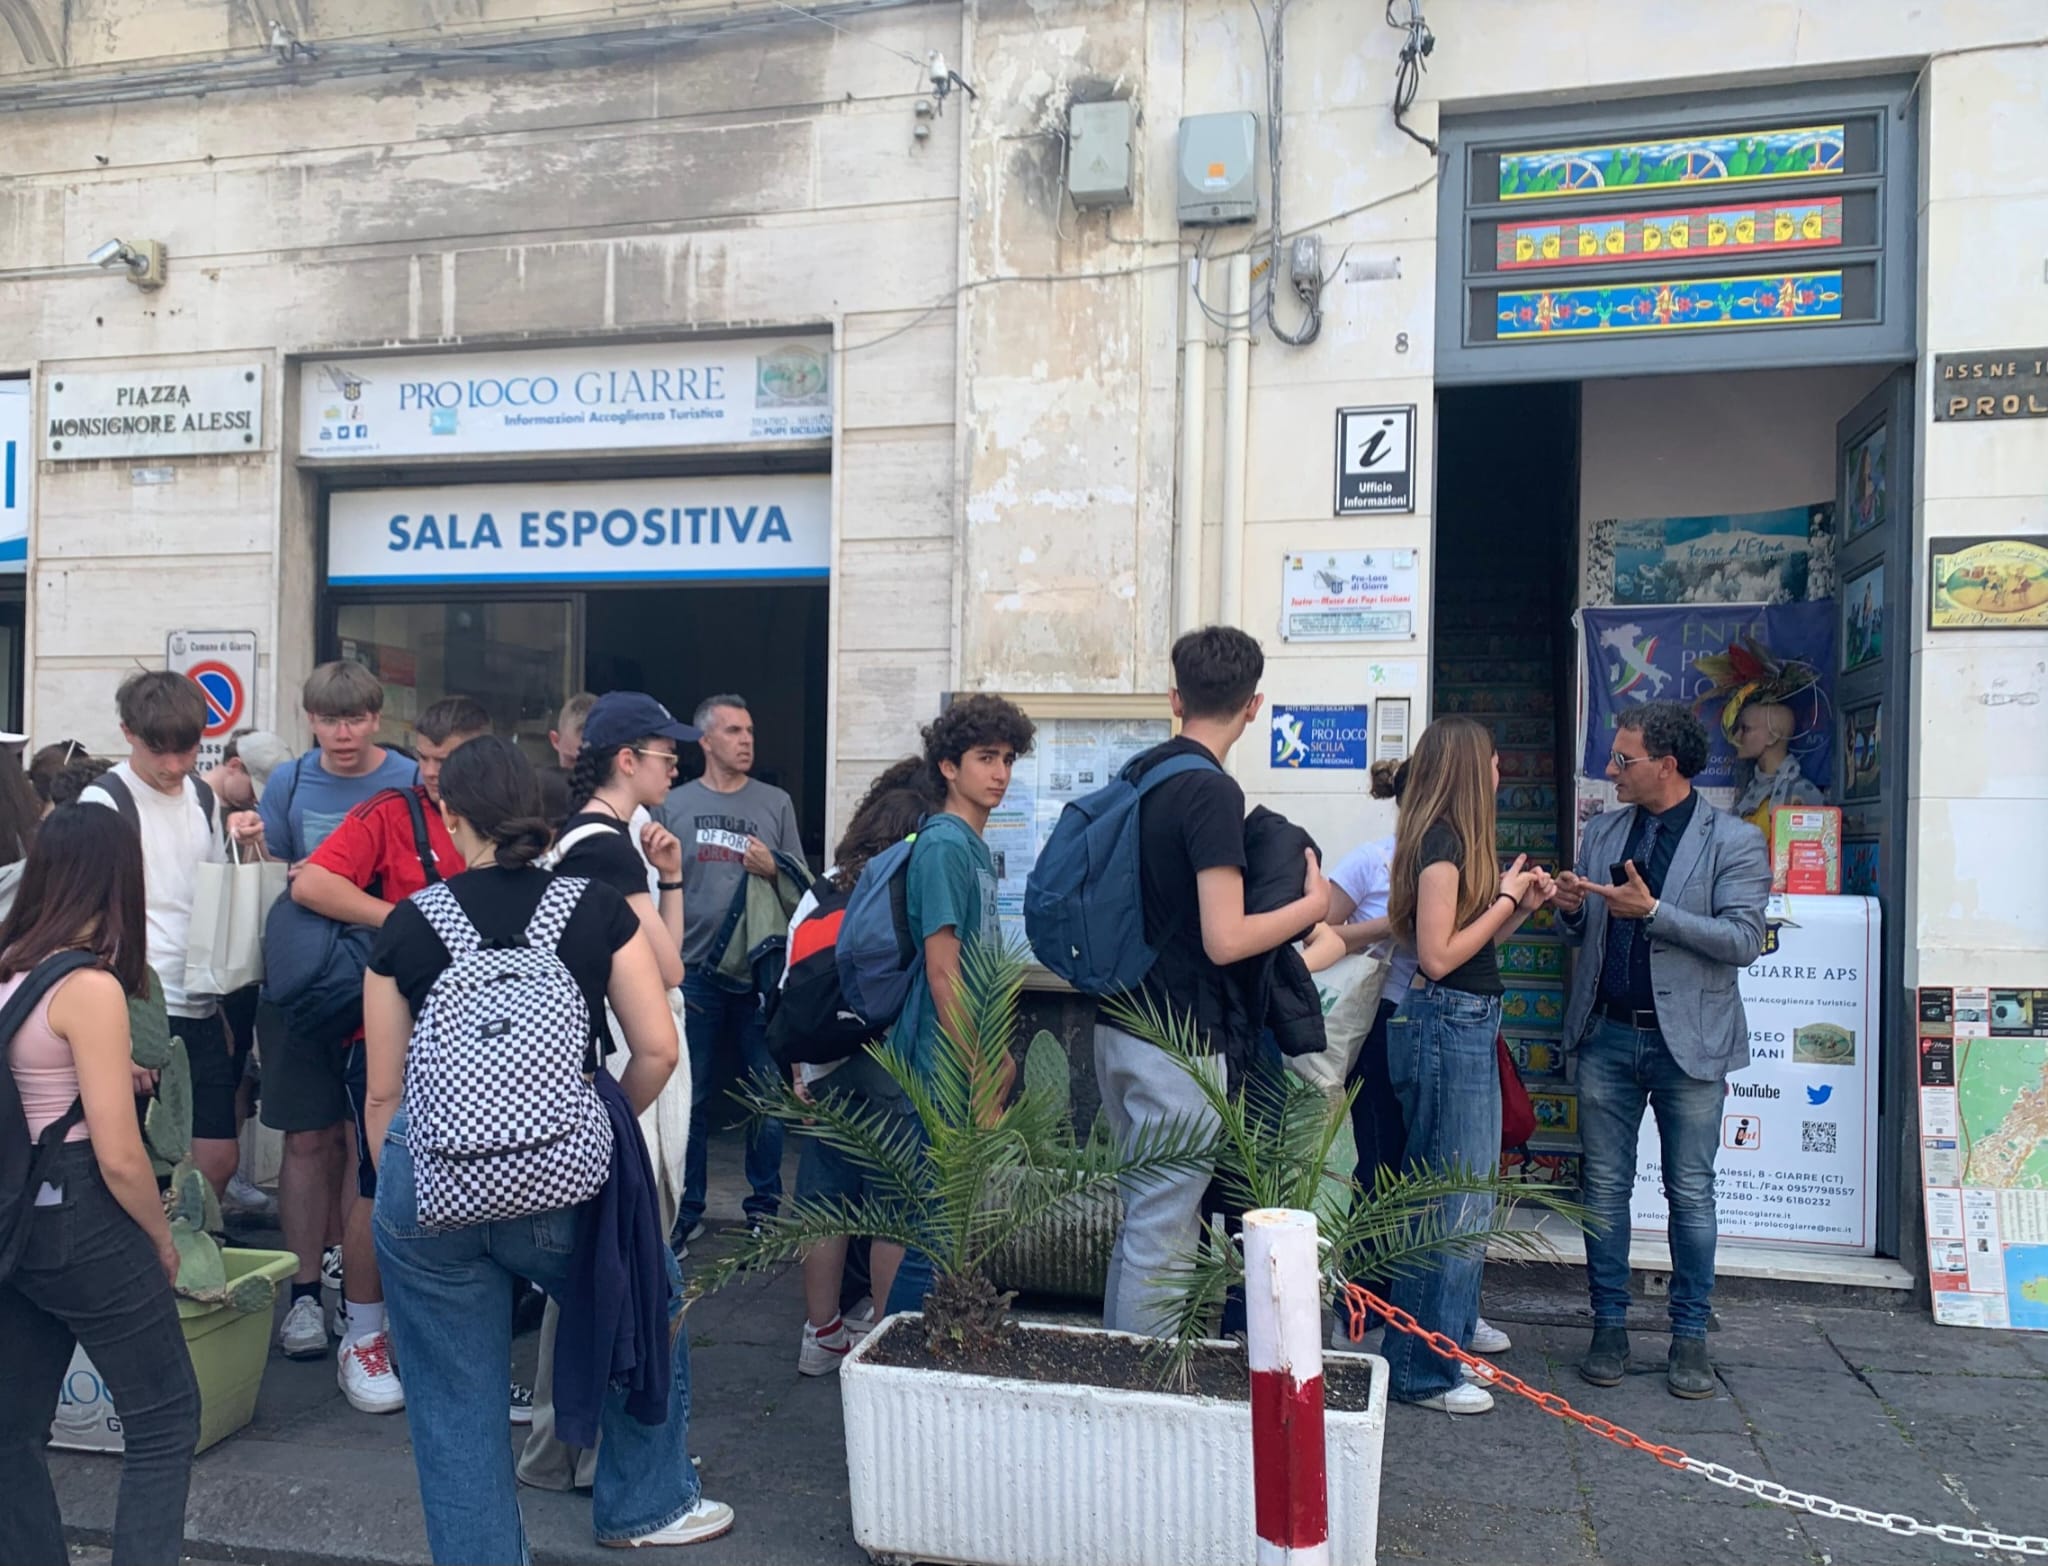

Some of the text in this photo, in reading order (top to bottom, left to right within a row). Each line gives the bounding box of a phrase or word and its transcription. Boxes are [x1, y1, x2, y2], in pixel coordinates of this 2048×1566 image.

[1395, 332, 1409, 354] 8
[400, 365, 726, 411] PRO LOCO GIARRE
[116, 384, 191, 408] PIAZZA
[49, 410, 252, 438] MONSIGNORE ALESSI
[504, 407, 725, 427] Informazioni Accoglienza Turistica
[1359, 480, 1393, 494] Ufficio
[1343, 493, 1407, 508] Informazioni
[387, 505, 792, 552] SALA ESPOSITIVA
[1351, 582, 1389, 590] di Giarre
[1682, 622, 1769, 645] ENTE
[220, 641, 226, 652] di
[1311, 718, 1336, 728] ENTE
[1311, 728, 1367, 741] PRO LOCO
[1310, 741, 1345, 753] SICILIA
[701, 829, 718, 842] OF
[1747, 965, 1857, 981] GIARRE APS
[1759, 996, 1815, 1007] Accoglienza
[1817, 999, 1858, 1008] Turistica
[1747, 1031, 1785, 1043] USEO
[1731, 1083, 1781, 1100] YouTube
[1718, 1167, 1756, 1179] Alessi,
[1758, 1170, 1766, 1178] 8
[1774, 1171, 1818, 1182] GIARRE
[1821, 1174, 1844, 1185] (CT)
[1735, 1181, 1784, 1192] TEL./Fax
[1787, 1183, 1856, 1197] 0957798557
[1762, 1194, 1784, 1203] 349
[1786, 1196, 1832, 1207] 6180232
[1754, 1220, 1853, 1234] prolocogiarre@pec.it
